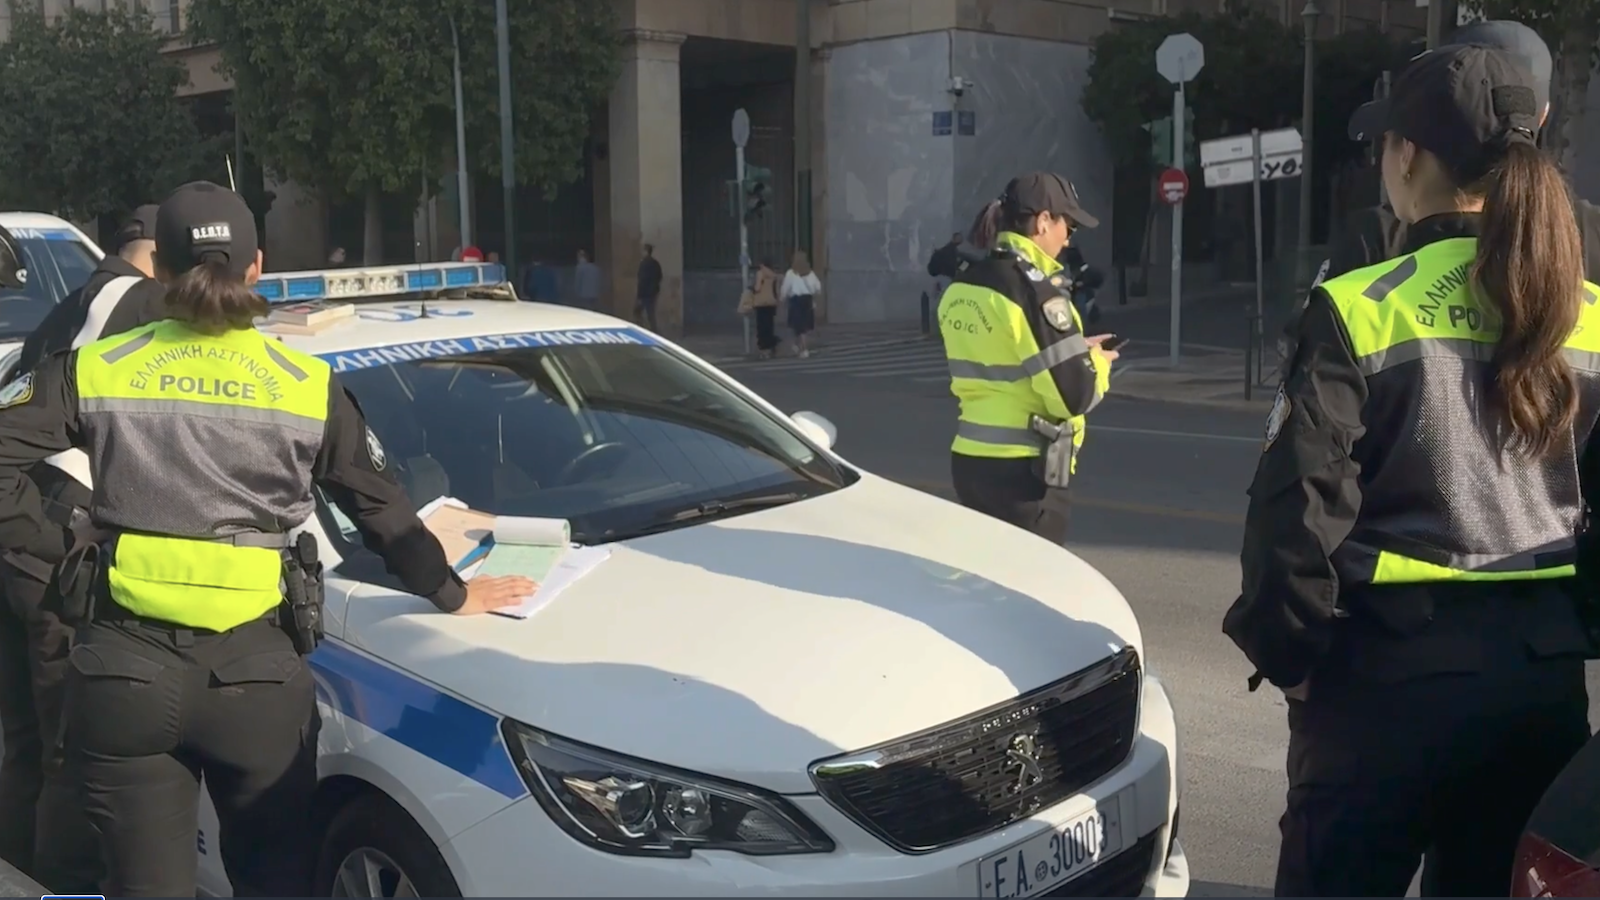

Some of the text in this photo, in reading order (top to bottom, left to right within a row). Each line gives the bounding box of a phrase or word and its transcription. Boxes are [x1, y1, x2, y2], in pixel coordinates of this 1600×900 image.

[130, 344, 283, 402] ΕΛΛΗΝΙΚΗ ΑΣΤΥΝΟΜΙΑ
[332, 331, 643, 373] ΛΗΝΙΚΗ ΑΣΤΥΝΟΜΙΑ
[159, 374, 256, 400] POLICE
